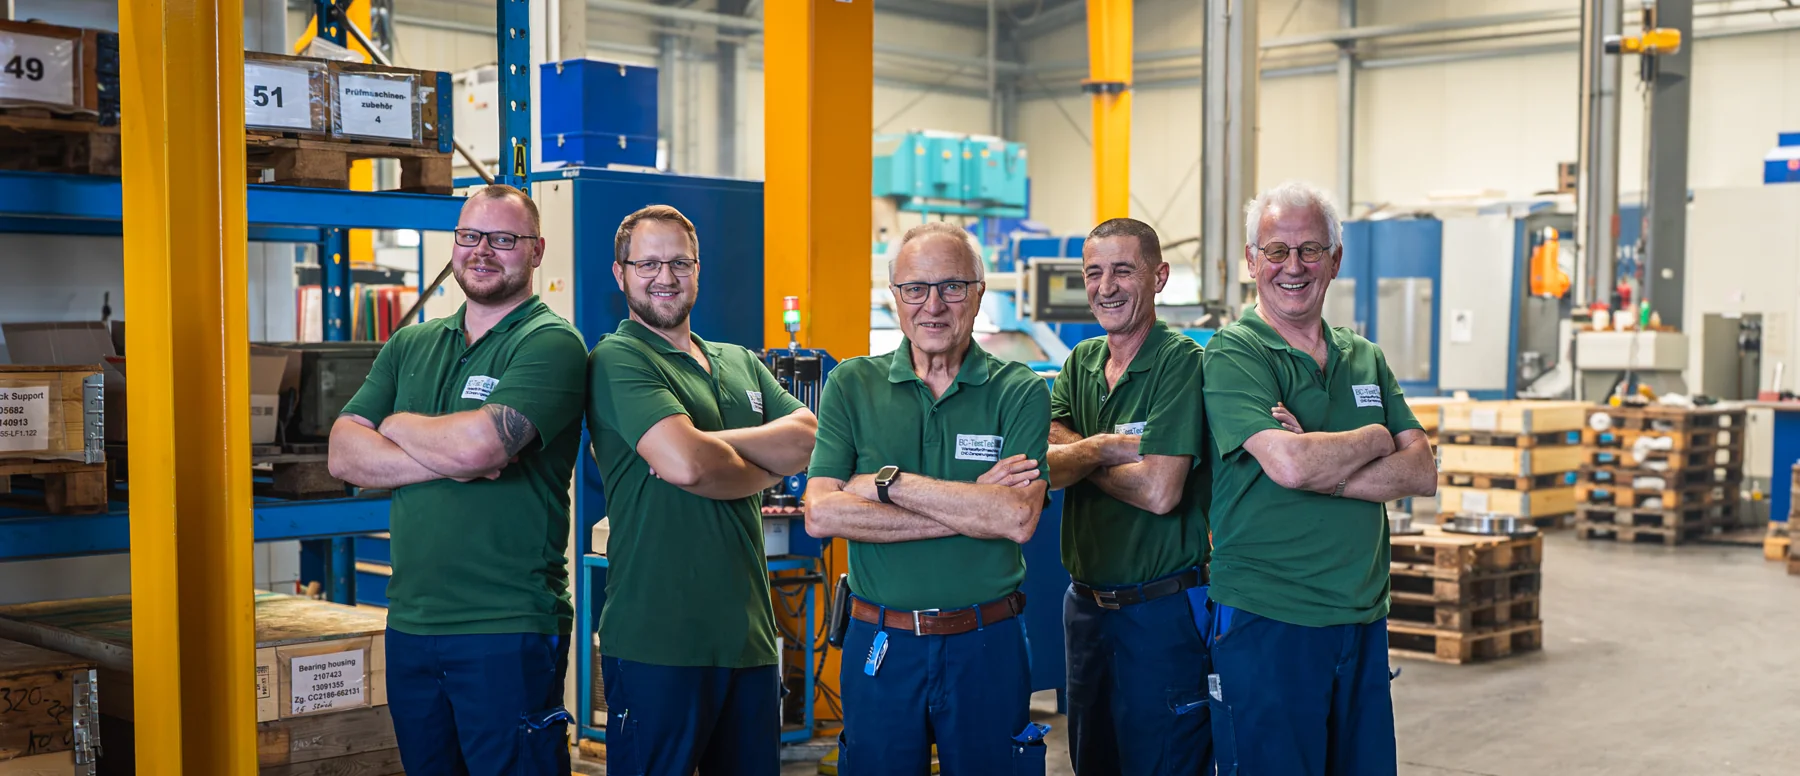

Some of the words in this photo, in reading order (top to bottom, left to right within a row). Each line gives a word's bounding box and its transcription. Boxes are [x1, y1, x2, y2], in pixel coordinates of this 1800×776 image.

[4, 55, 44, 82] 49
[253, 85, 283, 108] 51
[361, 101, 393, 110] zubehör
[375, 115, 381, 123] 4
[515, 146, 525, 174] A
[11, 392, 44, 401] Support
[299, 663, 326, 672] Bearing
[328, 659, 356, 667] housing
[313, 670, 342, 681] 2107423
[312, 680, 344, 691] 13091355
[294, 696, 306, 704] Zg.
[308, 687, 360, 702] CC2186-662131
